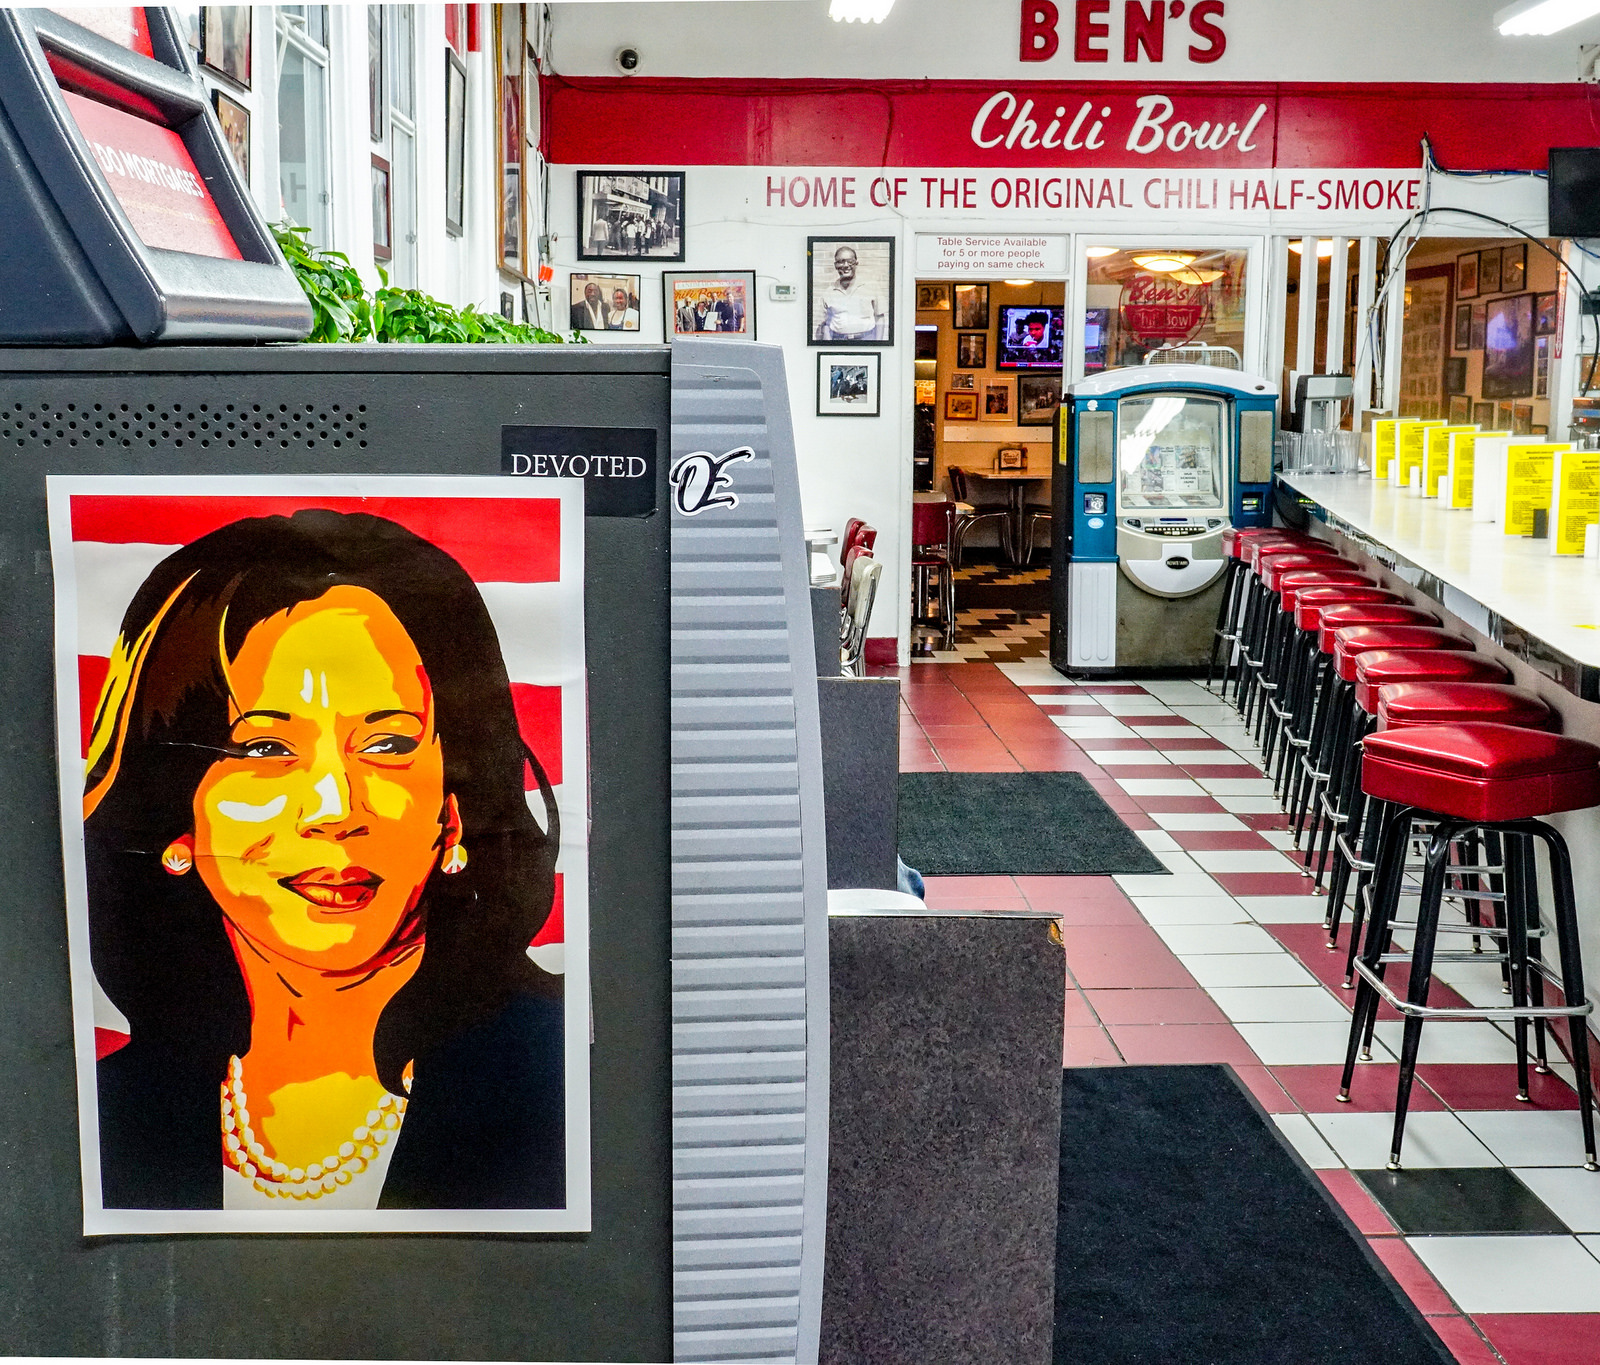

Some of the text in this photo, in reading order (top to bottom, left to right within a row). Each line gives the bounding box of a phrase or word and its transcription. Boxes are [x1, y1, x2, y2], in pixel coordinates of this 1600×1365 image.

[1019, 0, 1227, 64] BEN'S
[971, 91, 1268, 154] Chili Bowl
[93, 142, 204, 198] DO MORTGAGES
[766, 176, 1421, 210] HOME OF THE ORIGINAL CHILI HALF-SMOKE
[937, 237, 1047, 247] Table Service Available
[943, 249, 956, 257] for
[959, 249, 965, 257] 5
[1008, 250, 1041, 259] people
[937, 260, 970, 270] paying
[1016, 260, 1045, 269] check
[1117, 276, 1190, 302] Ben's
[511, 453, 647, 478] DEVOTED
